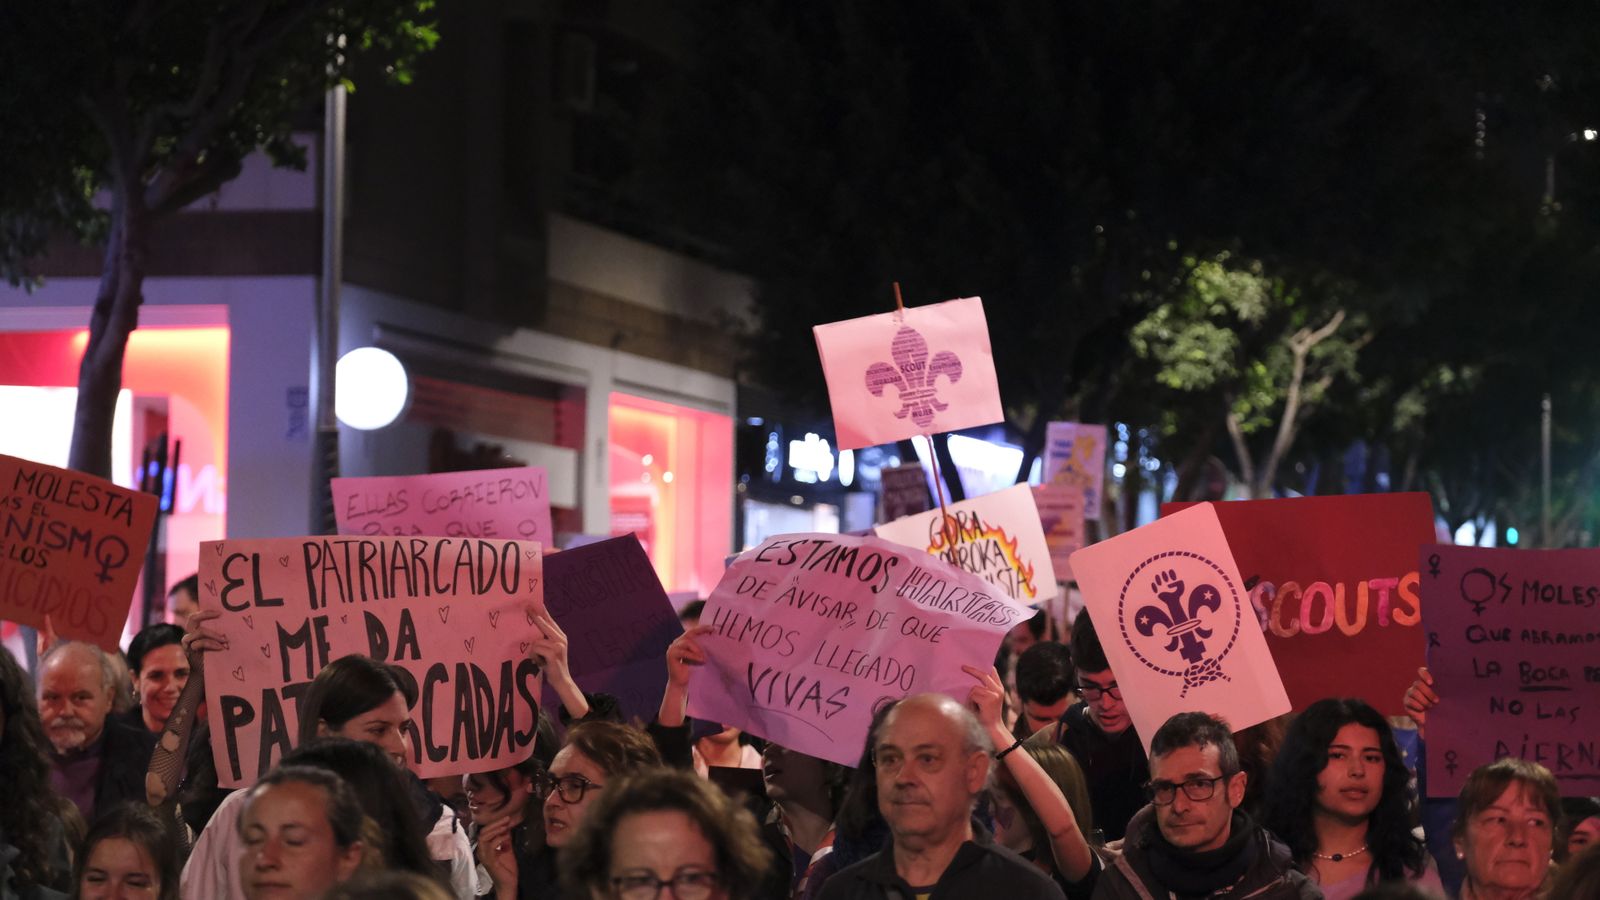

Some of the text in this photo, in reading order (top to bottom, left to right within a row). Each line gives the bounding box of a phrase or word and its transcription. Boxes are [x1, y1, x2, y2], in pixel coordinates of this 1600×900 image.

[900, 361, 926, 373] SCOUT
[12, 467, 134, 528] MOLESTA
[31, 501, 50, 517] EL
[346, 474, 542, 520] ELLAS CORRIERON
[1, 512, 131, 584] NISMO
[9, 543, 48, 569] LOS
[445, 519, 499, 538] QUE
[0, 562, 115, 637] ICIDIOS
[219, 538, 521, 612] EL PATRIARCADO
[755, 538, 1021, 628] ESTAMOS HARTAS
[1247, 570, 1422, 638] SCOUTS
[1521, 580, 1600, 609] MOLES
[735, 575, 777, 602] DE
[865, 608, 896, 632] DE
[900, 616, 950, 644] QUE
[275, 608, 422, 682] ME DA
[709, 606, 801, 658] HEMOS
[813, 640, 917, 692] LLEGADO
[1472, 657, 1502, 679] LA
[1518, 661, 1569, 685] BOCA
[746, 661, 851, 721] VIVAS
[1489, 695, 1581, 725] NO LAS
